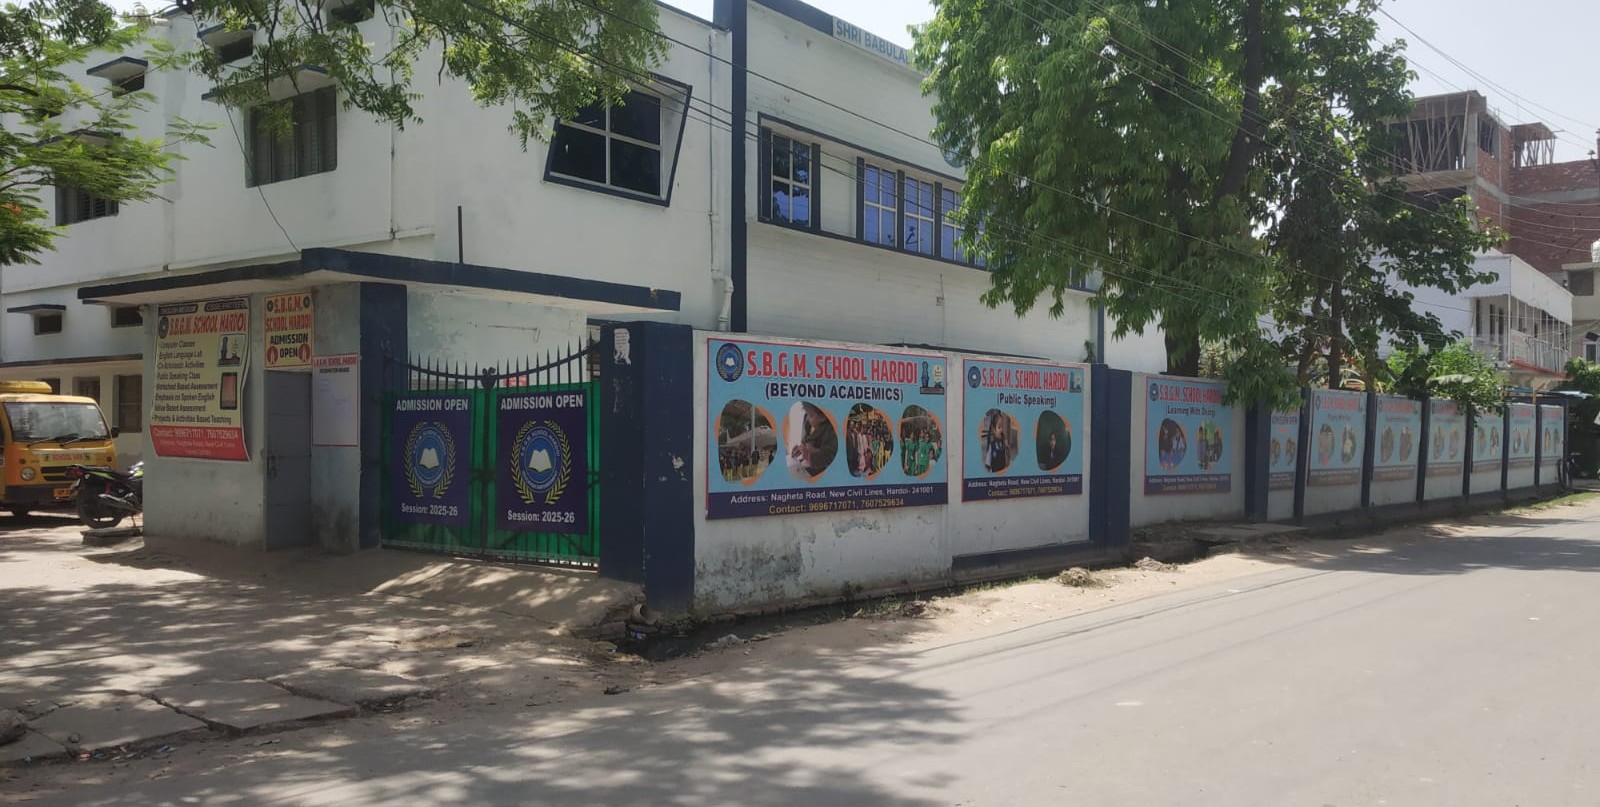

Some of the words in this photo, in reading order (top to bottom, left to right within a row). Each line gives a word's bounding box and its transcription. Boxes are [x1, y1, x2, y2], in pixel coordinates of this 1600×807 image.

[836, 20, 862, 44] SHRI
[194, 314, 218, 334] SCHOOL
[220, 312, 247, 333] HARDOI
[266, 316, 288, 331] SCHOOL
[289, 314, 311, 330] HARDOI
[270, 333, 308, 345] ADMISSION
[280, 347, 298, 358] OPEN
[747, 350, 811, 378] S.B.G.M.
[815, 355, 868, 382] SCHOOL
[871, 359, 917, 384] HARDOI
[191, 382, 218, 390] Assessment
[982, 368, 1014, 388] S.B.G.M.
[1015, 369, 1042, 389] SCHOOL
[1043, 371, 1068, 391] HARDOI
[198, 394, 215, 403] English
[766, 382, 826, 400] (BEYOND
[830, 385, 904, 403] ACADEMICS)
[1183, 386, 1202, 403] SCHOOL
[396, 399, 442, 412] ADMISSION
[445, 398, 469, 411] OPEN
[501, 395, 553, 410] ADMISSION
[556, 394, 583, 408] OPEN
[997, 393, 1021, 406] (Public
[1023, 394, 1057, 408] Speaking)
[176, 414, 195, 422] Activities
[196, 415, 210, 423] Based
[211, 414, 232, 424] Teaching
[731, 494, 769, 505] Address:
[771, 492, 804, 503] Nagheta
[830, 490, 846, 499] New
[847, 489, 864, 498] Civil
[865, 488, 885, 498] Lines,
[912, 486, 934, 495] 241001
[401, 502, 429, 514] Session:
[429, 503, 458, 516] 2025-26
[507, 509, 541, 522] Session:
[542, 511, 575, 524] 2025-26
[769, 505, 807, 515] Contact:
